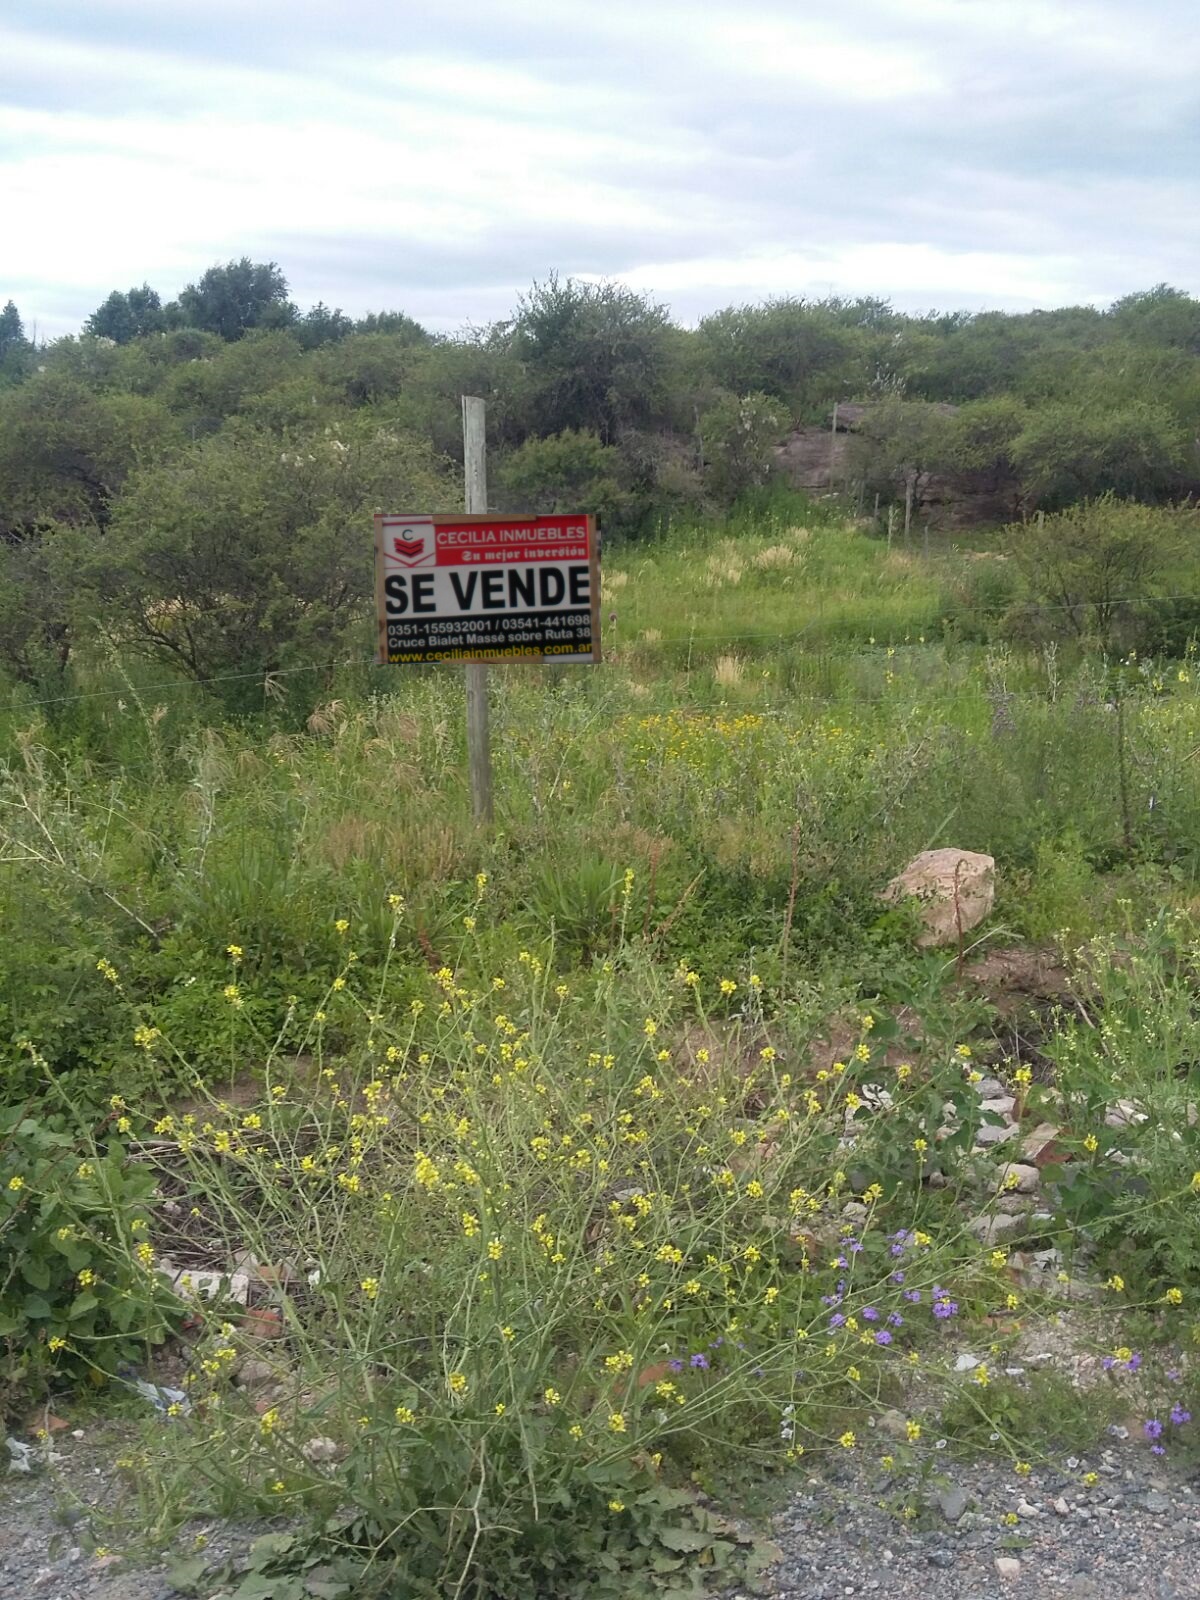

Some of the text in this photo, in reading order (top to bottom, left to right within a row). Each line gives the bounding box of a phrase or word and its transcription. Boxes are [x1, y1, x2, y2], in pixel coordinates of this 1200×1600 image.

[437, 526, 586, 545] CECILIA INMUEBLES
[485, 548, 520, 562] mejor
[524, 546, 586, 559] inversión
[385, 566, 591, 615] SE VENDE
[388, 620, 492, 636] 0351-155932001
[502, 615, 591, 630] 03541-441698
[388, 627, 591, 648] Cruce Bialet Massé sobre Ruta 38
[388, 643, 592, 663] www.ceciliainmuebles.com.ar
